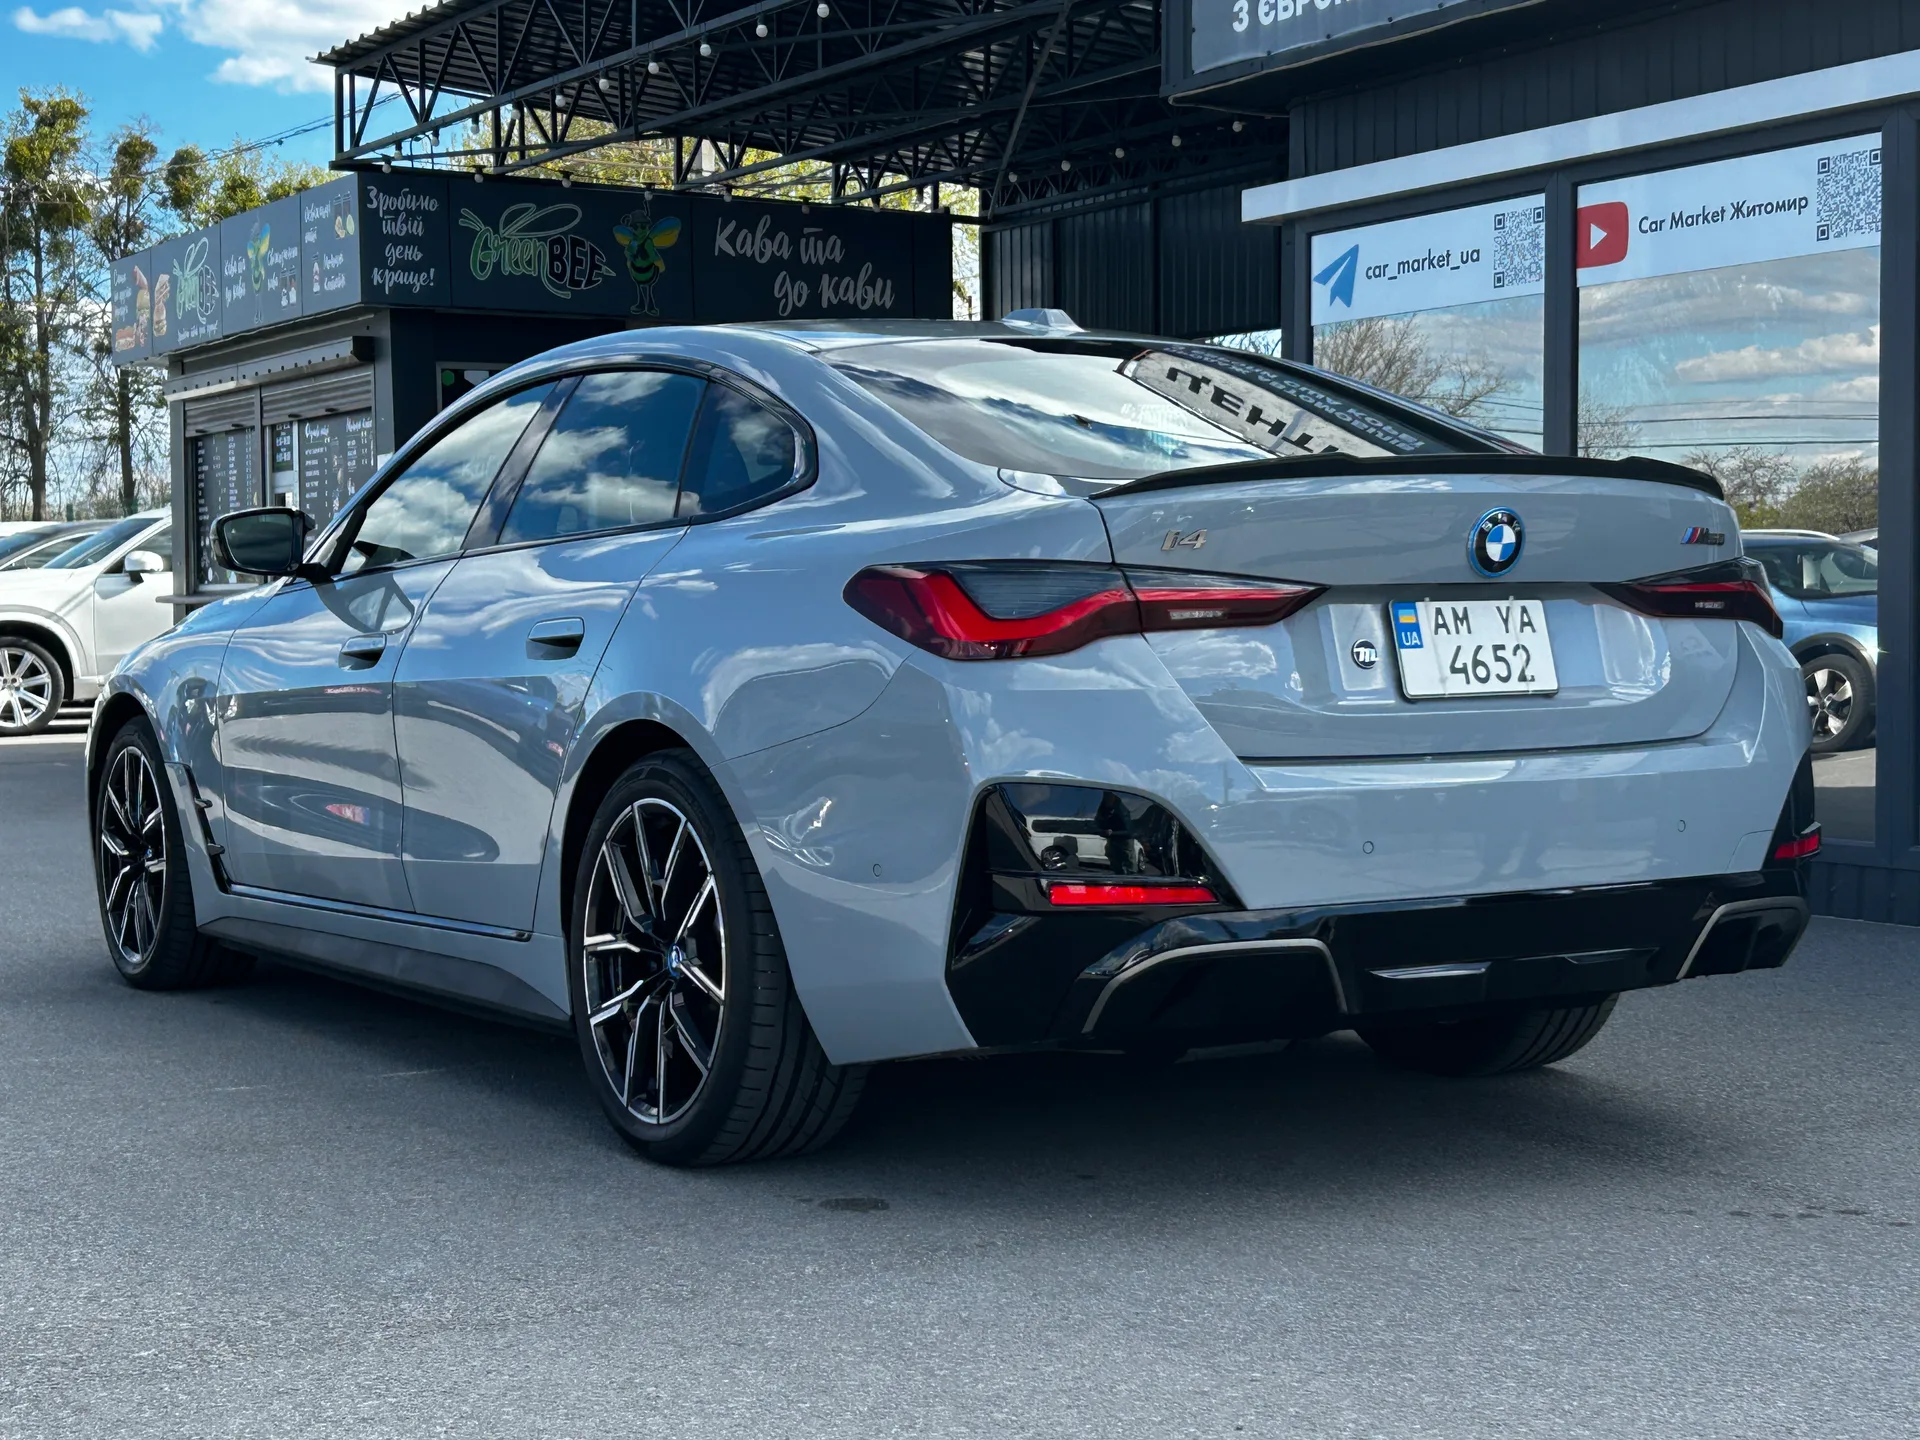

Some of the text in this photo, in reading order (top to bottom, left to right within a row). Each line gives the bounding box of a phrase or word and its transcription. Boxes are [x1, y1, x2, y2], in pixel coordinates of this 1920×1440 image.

[366, 185, 440, 218] Зробимо
[1638, 196, 1809, 234] Car Market Житомир
[382, 211, 425, 236] твій
[385, 242, 423, 267] день
[714, 214, 846, 266] Кава та
[1365, 248, 1481, 281] car_market_ua
[371, 267, 435, 295] краще!
[773, 261, 895, 316] до кави
[1161, 528, 1208, 551] i4
[1434, 605, 1536, 635] AM YA
[1402, 631, 1421, 646] UA
[1450, 643, 1536, 685] 4652
